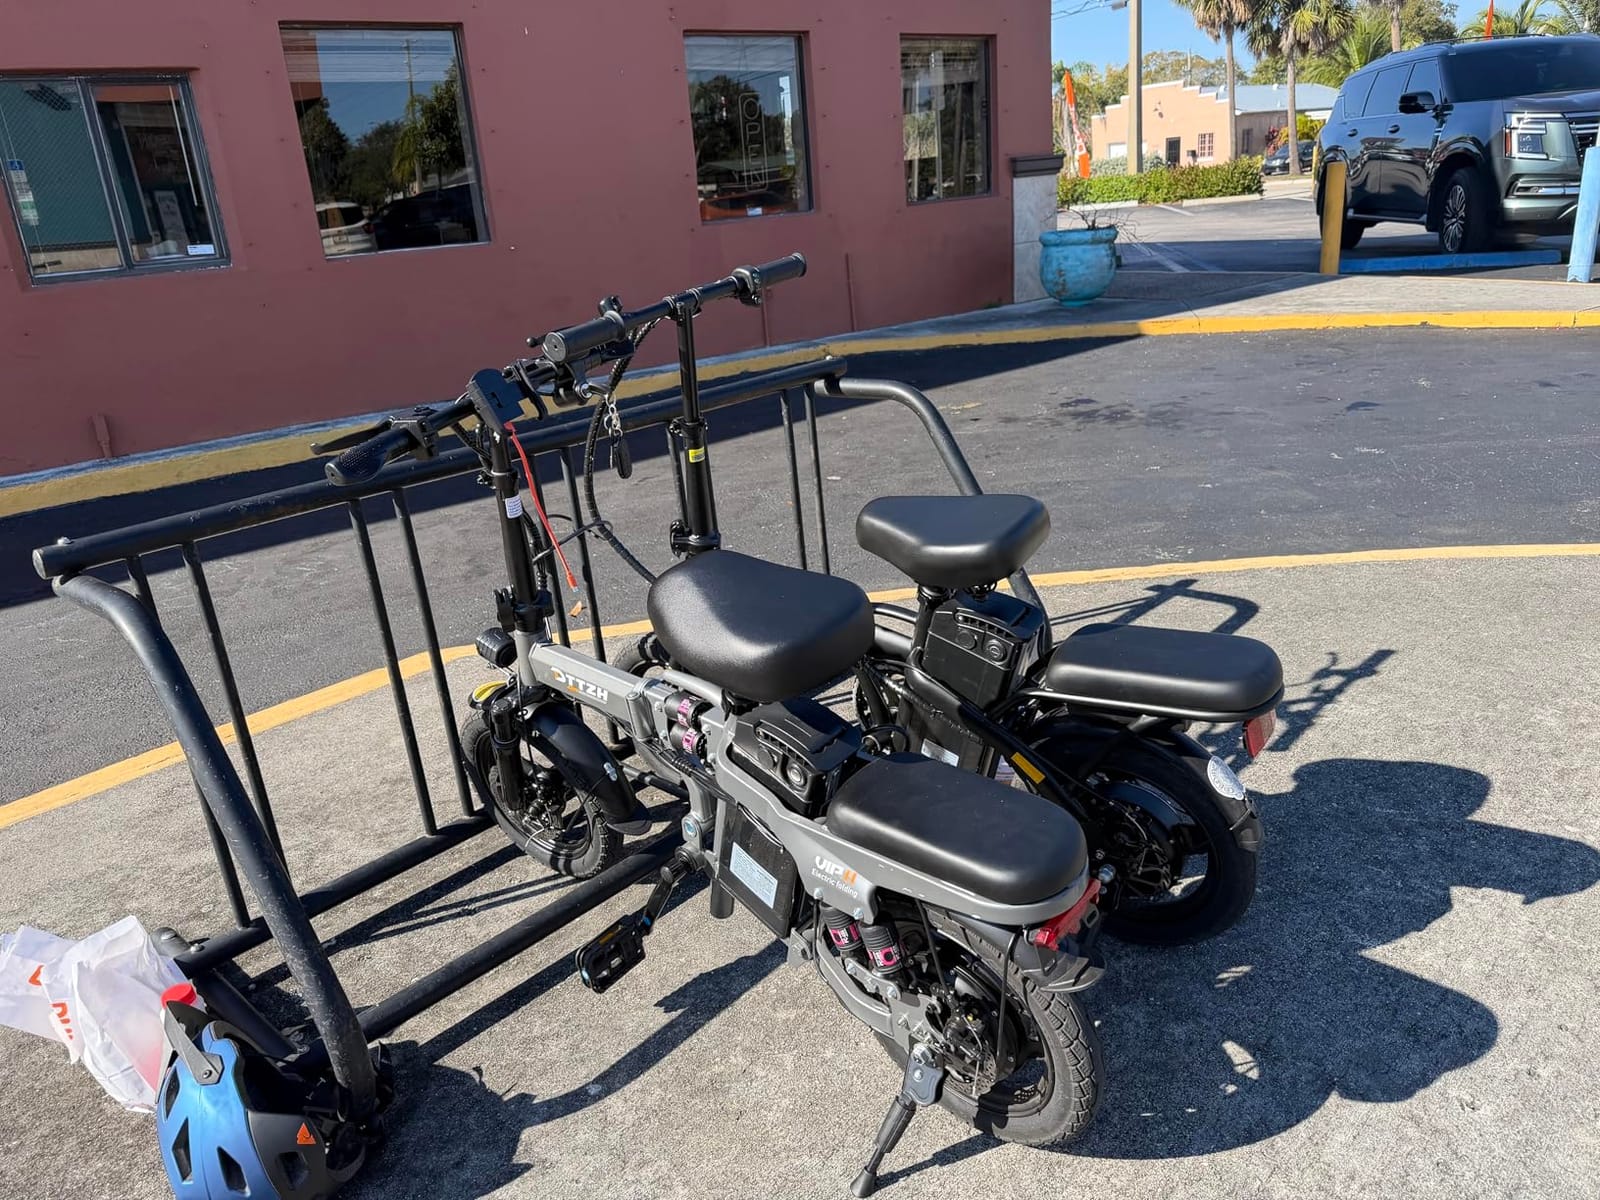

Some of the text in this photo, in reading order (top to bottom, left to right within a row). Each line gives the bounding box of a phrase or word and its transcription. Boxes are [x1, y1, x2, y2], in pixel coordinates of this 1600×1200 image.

[743, 97, 765, 187] OPEN
[811, 867, 858, 899] Electric folding
